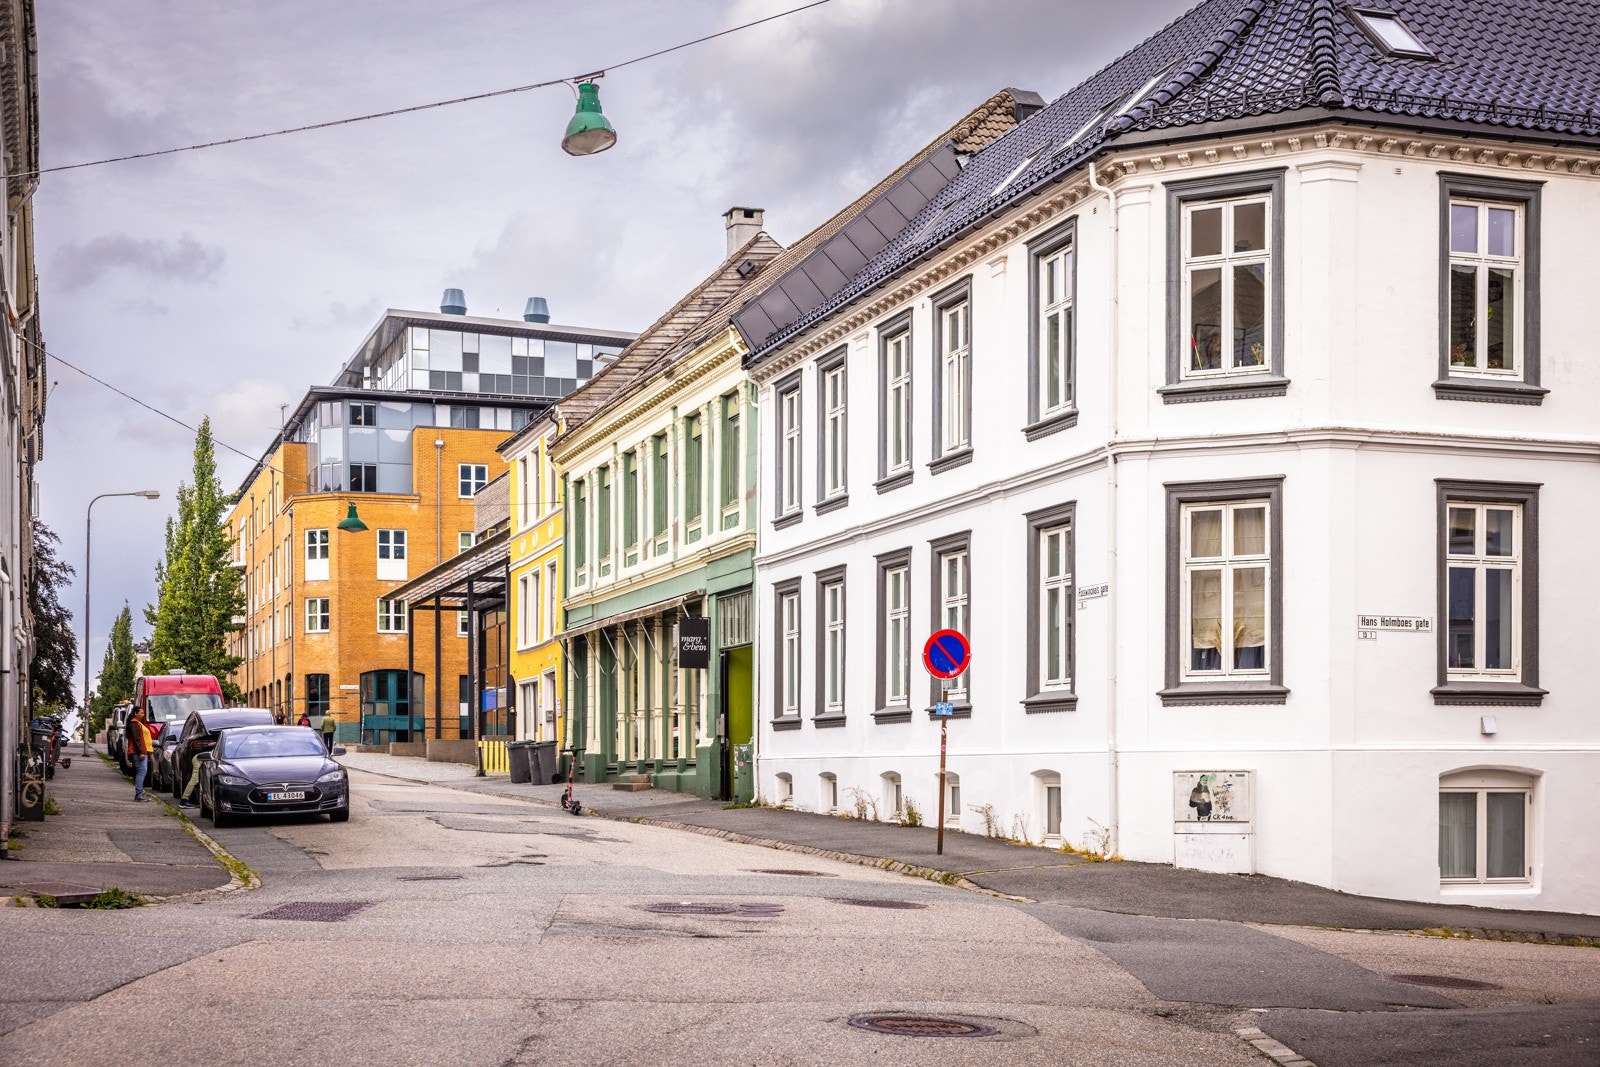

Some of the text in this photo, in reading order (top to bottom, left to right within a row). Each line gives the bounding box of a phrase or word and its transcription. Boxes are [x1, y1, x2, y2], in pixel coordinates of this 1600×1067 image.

[1100, 584, 1109, 596] gate
[1361, 616, 1430, 630] Hans Holmboes gate
